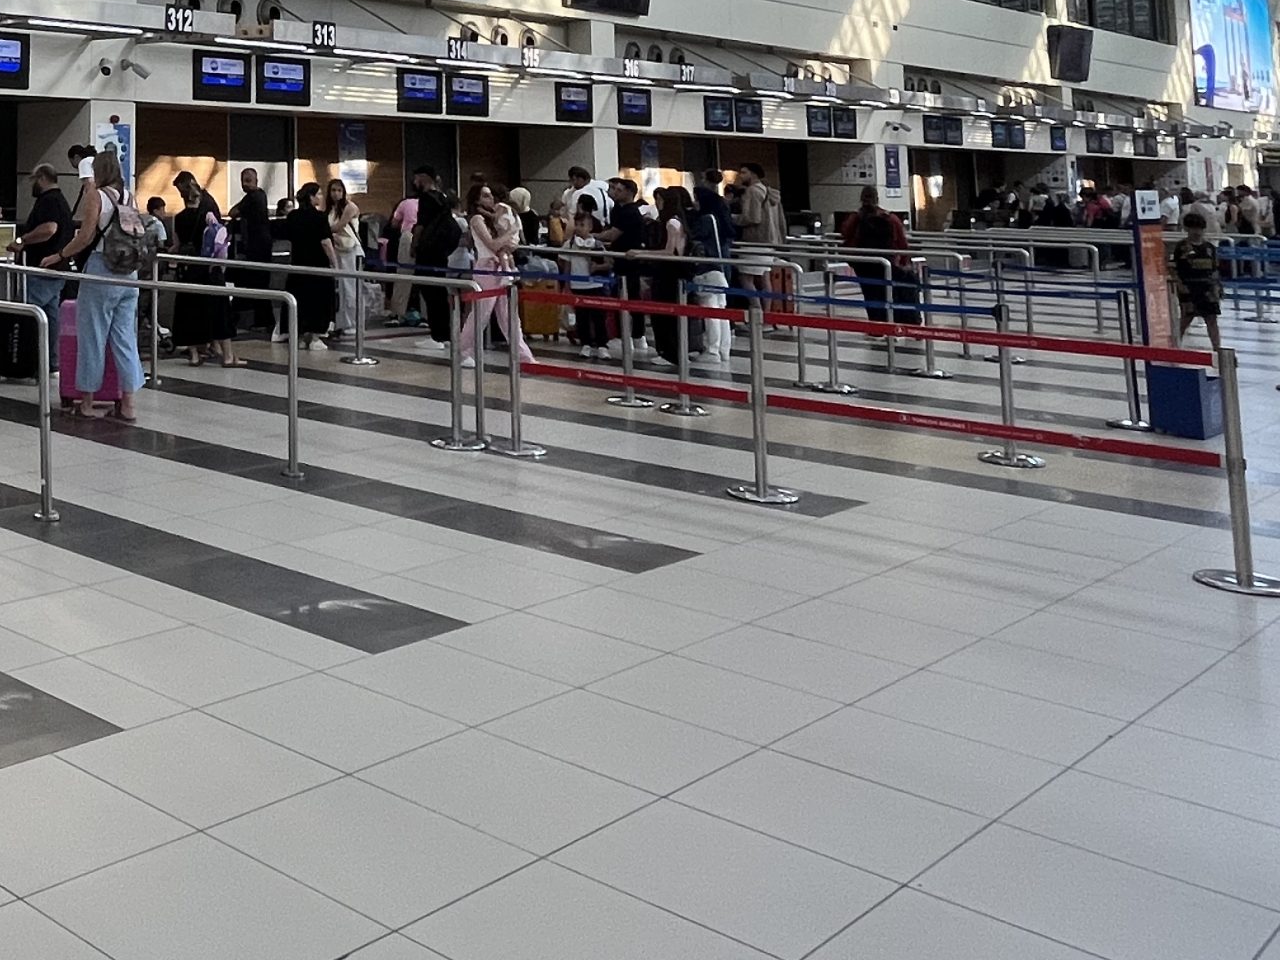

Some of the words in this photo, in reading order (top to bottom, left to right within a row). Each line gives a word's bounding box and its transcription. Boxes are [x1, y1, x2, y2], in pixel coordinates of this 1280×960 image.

[167, 7, 193, 33] 312
[314, 23, 336, 47] 313
[449, 40, 468, 59] 314
[522, 47, 540, 68] 315
[623, 58, 640, 78] 316
[681, 65, 695, 82] 317
